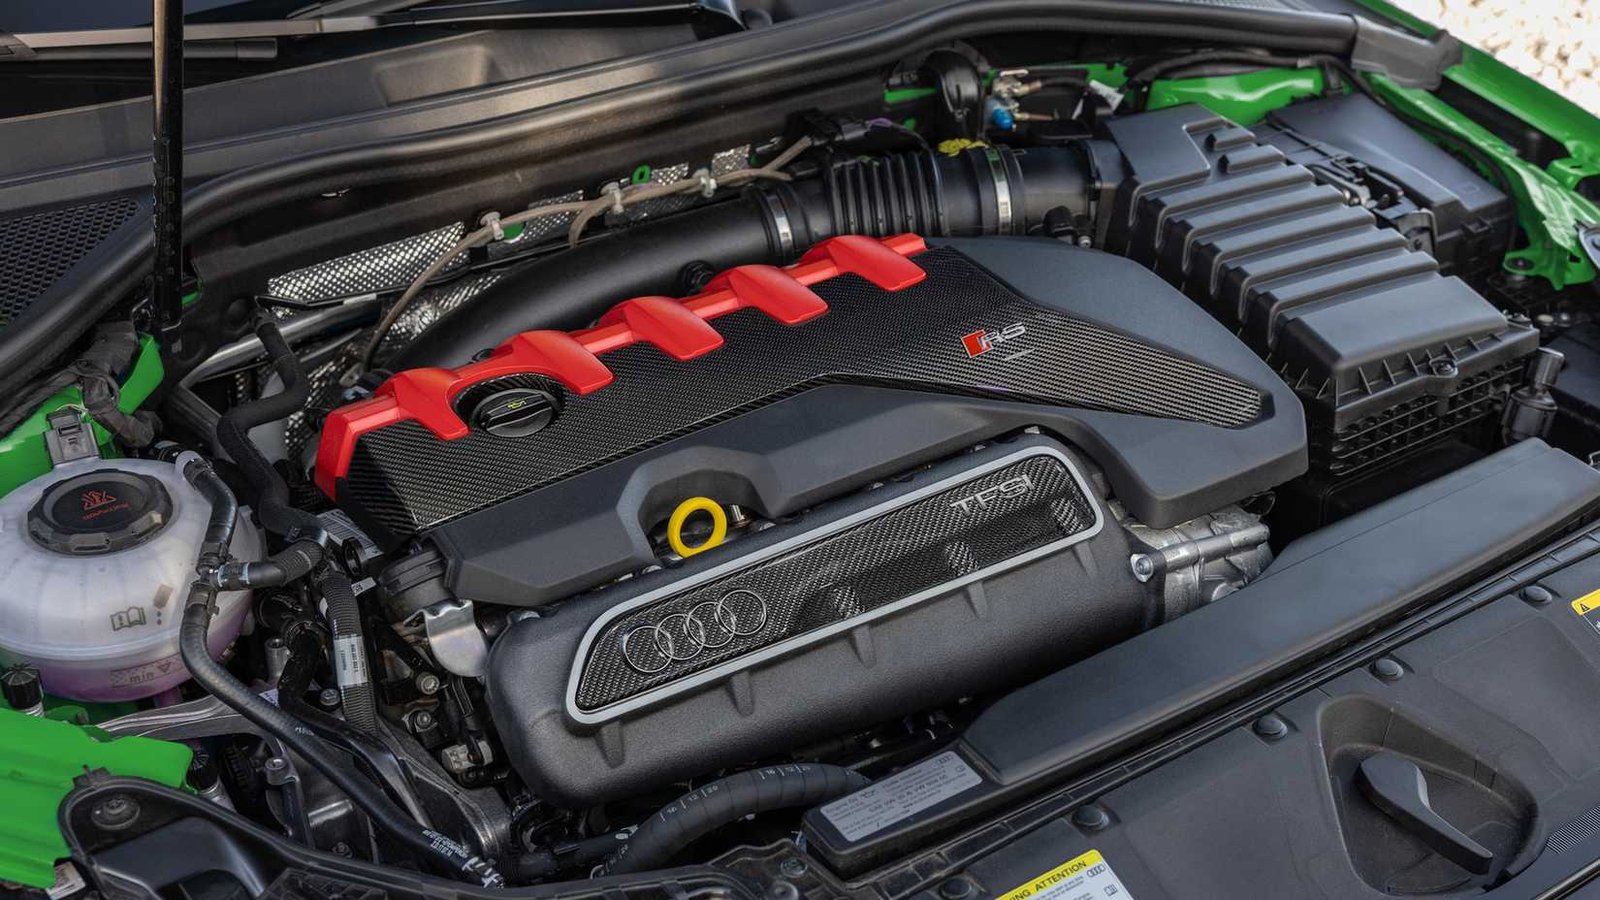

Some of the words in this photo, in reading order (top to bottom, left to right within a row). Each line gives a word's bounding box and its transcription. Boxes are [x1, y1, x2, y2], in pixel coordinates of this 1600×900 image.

[978, 322, 1026, 350] RS
[950, 474, 1035, 516] TFSI
[130, 666, 154, 683] min
[1035, 860, 1087, 892] ATTENTION
